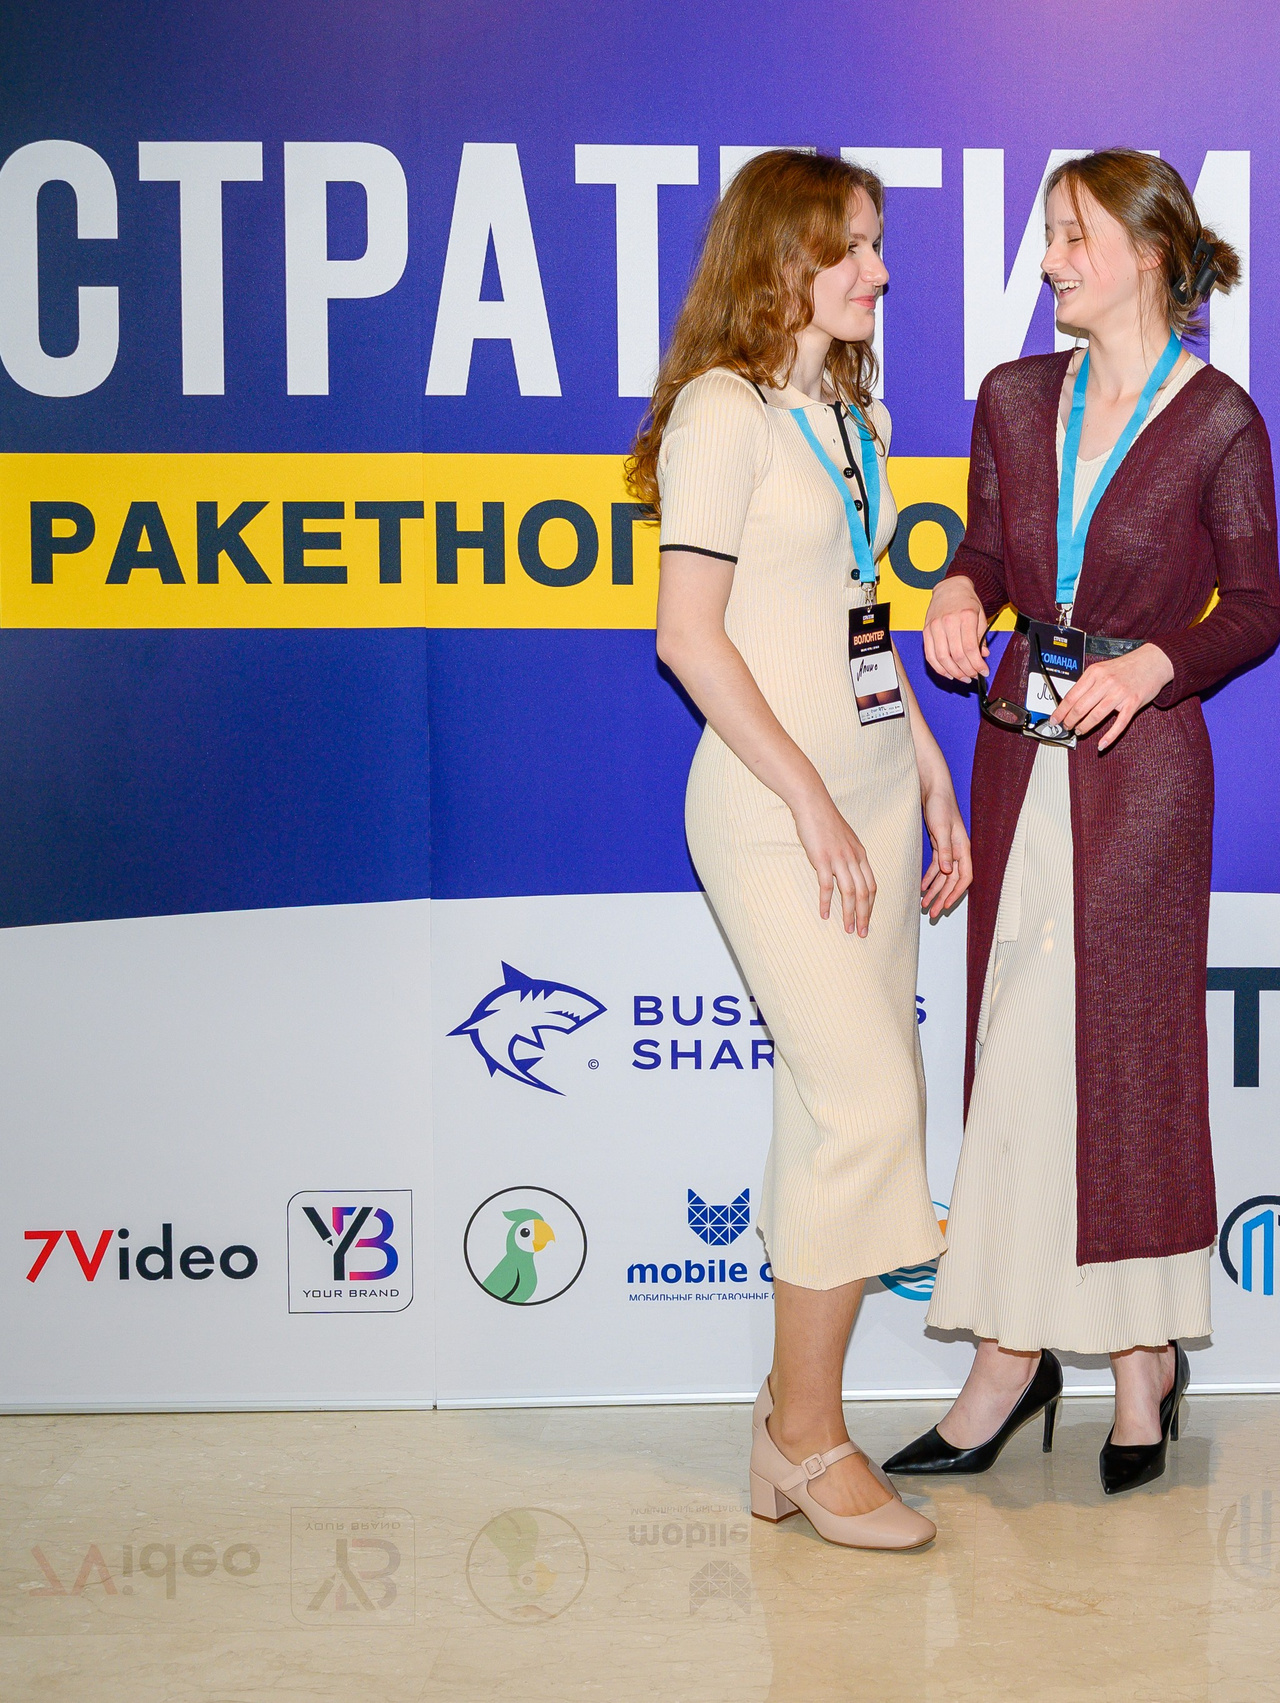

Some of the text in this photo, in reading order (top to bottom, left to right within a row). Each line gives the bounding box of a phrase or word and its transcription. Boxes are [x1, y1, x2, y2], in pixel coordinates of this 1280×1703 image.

[29, 499, 662, 588] РАКЕТНОГ
[853, 631, 884, 645] ВОЛОНТЕР
[632, 1039, 775, 1070] SHAR
[24, 1223, 258, 1283] 7Video
[626, 1259, 748, 1284] mobile
[302, 1288, 400, 1299] YOUR BRAND
